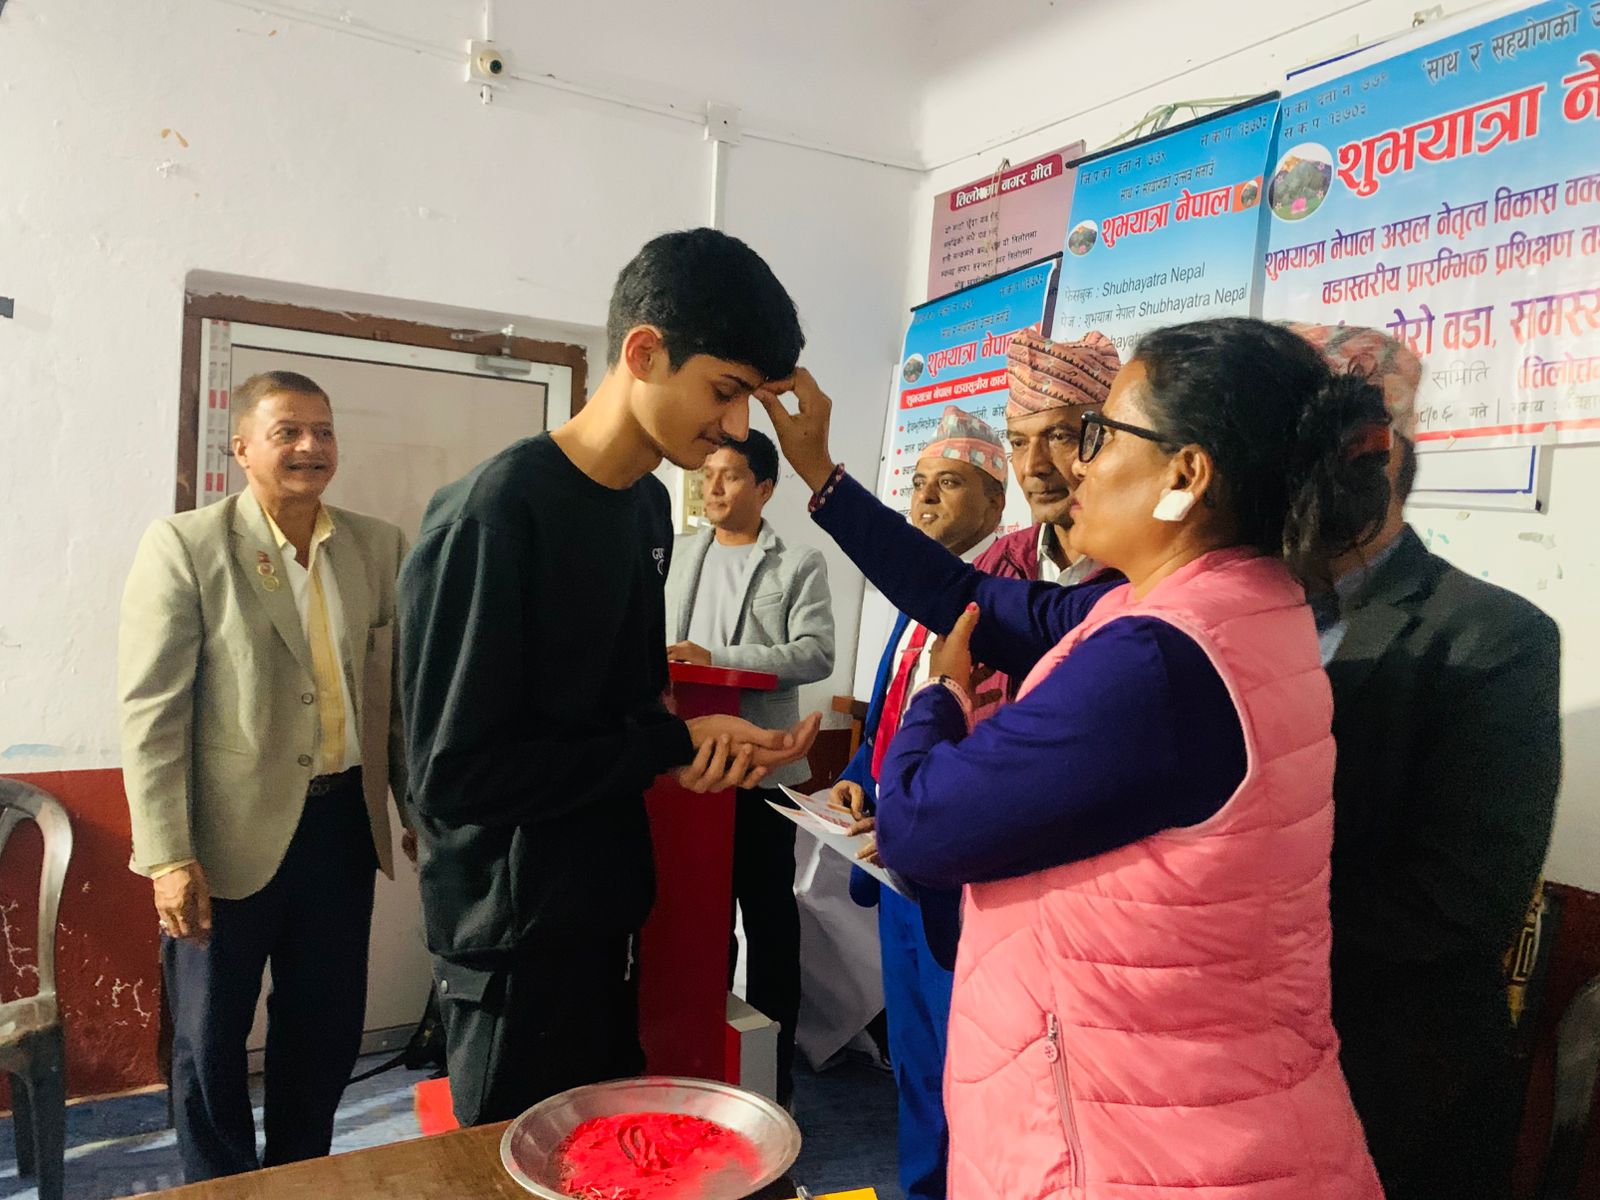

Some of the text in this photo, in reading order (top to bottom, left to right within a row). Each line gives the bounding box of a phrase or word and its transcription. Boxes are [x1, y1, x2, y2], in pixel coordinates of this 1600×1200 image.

[1337, 84, 1545, 197] शुभयात्रा
[1001, 172, 1028, 191] नगर
[1030, 162, 1053, 181] गीत
[1101, 188, 1233, 248] शुभयात्रा नेपाल
[1265, 240, 1326, 282] शुभयात्रा
[1331, 229, 1376, 260] नेपाल
[1381, 213, 1431, 251] असल
[1437, 201, 1489, 240] नेतृत्व
[1494, 183, 1559, 224] विकास
[1102, 272, 1167, 297] Shubhayatra
[1170, 262, 1206, 284] Nepal
[1322, 262, 1401, 305] वडास्तरीय
[1407, 247, 1489, 293] प्रारम्भिक
[1495, 231, 1575, 276] प्रशिक्षण
[1115, 303, 1136, 320] नेपाल
[1138, 295, 1210, 317] Shubhayatra
[1214, 282, 1248, 304] Nepal
[927, 342, 976, 378] शुभयात्रा
